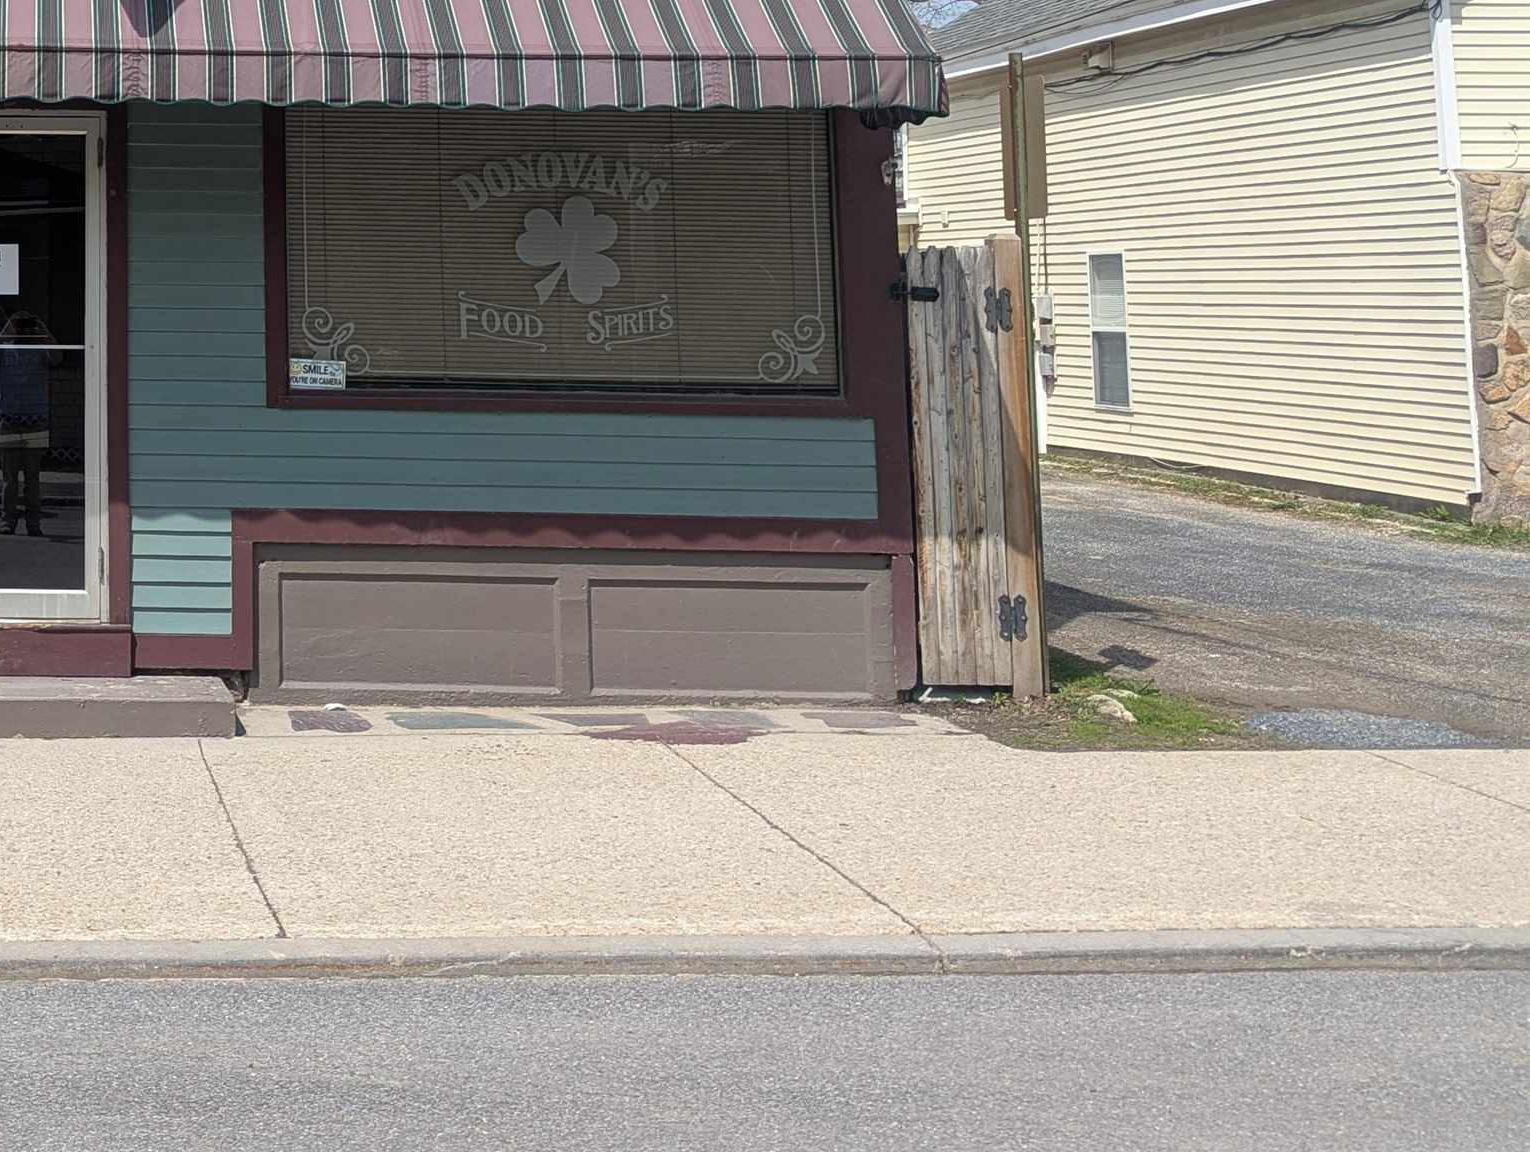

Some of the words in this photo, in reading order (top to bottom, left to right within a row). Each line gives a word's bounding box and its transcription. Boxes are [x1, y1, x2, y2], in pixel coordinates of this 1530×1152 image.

[452, 151, 669, 211] DONOVAN'S
[459, 302, 543, 339] FOOD
[586, 305, 674, 344] SPIRITS
[302, 364, 329, 375] SMILE
